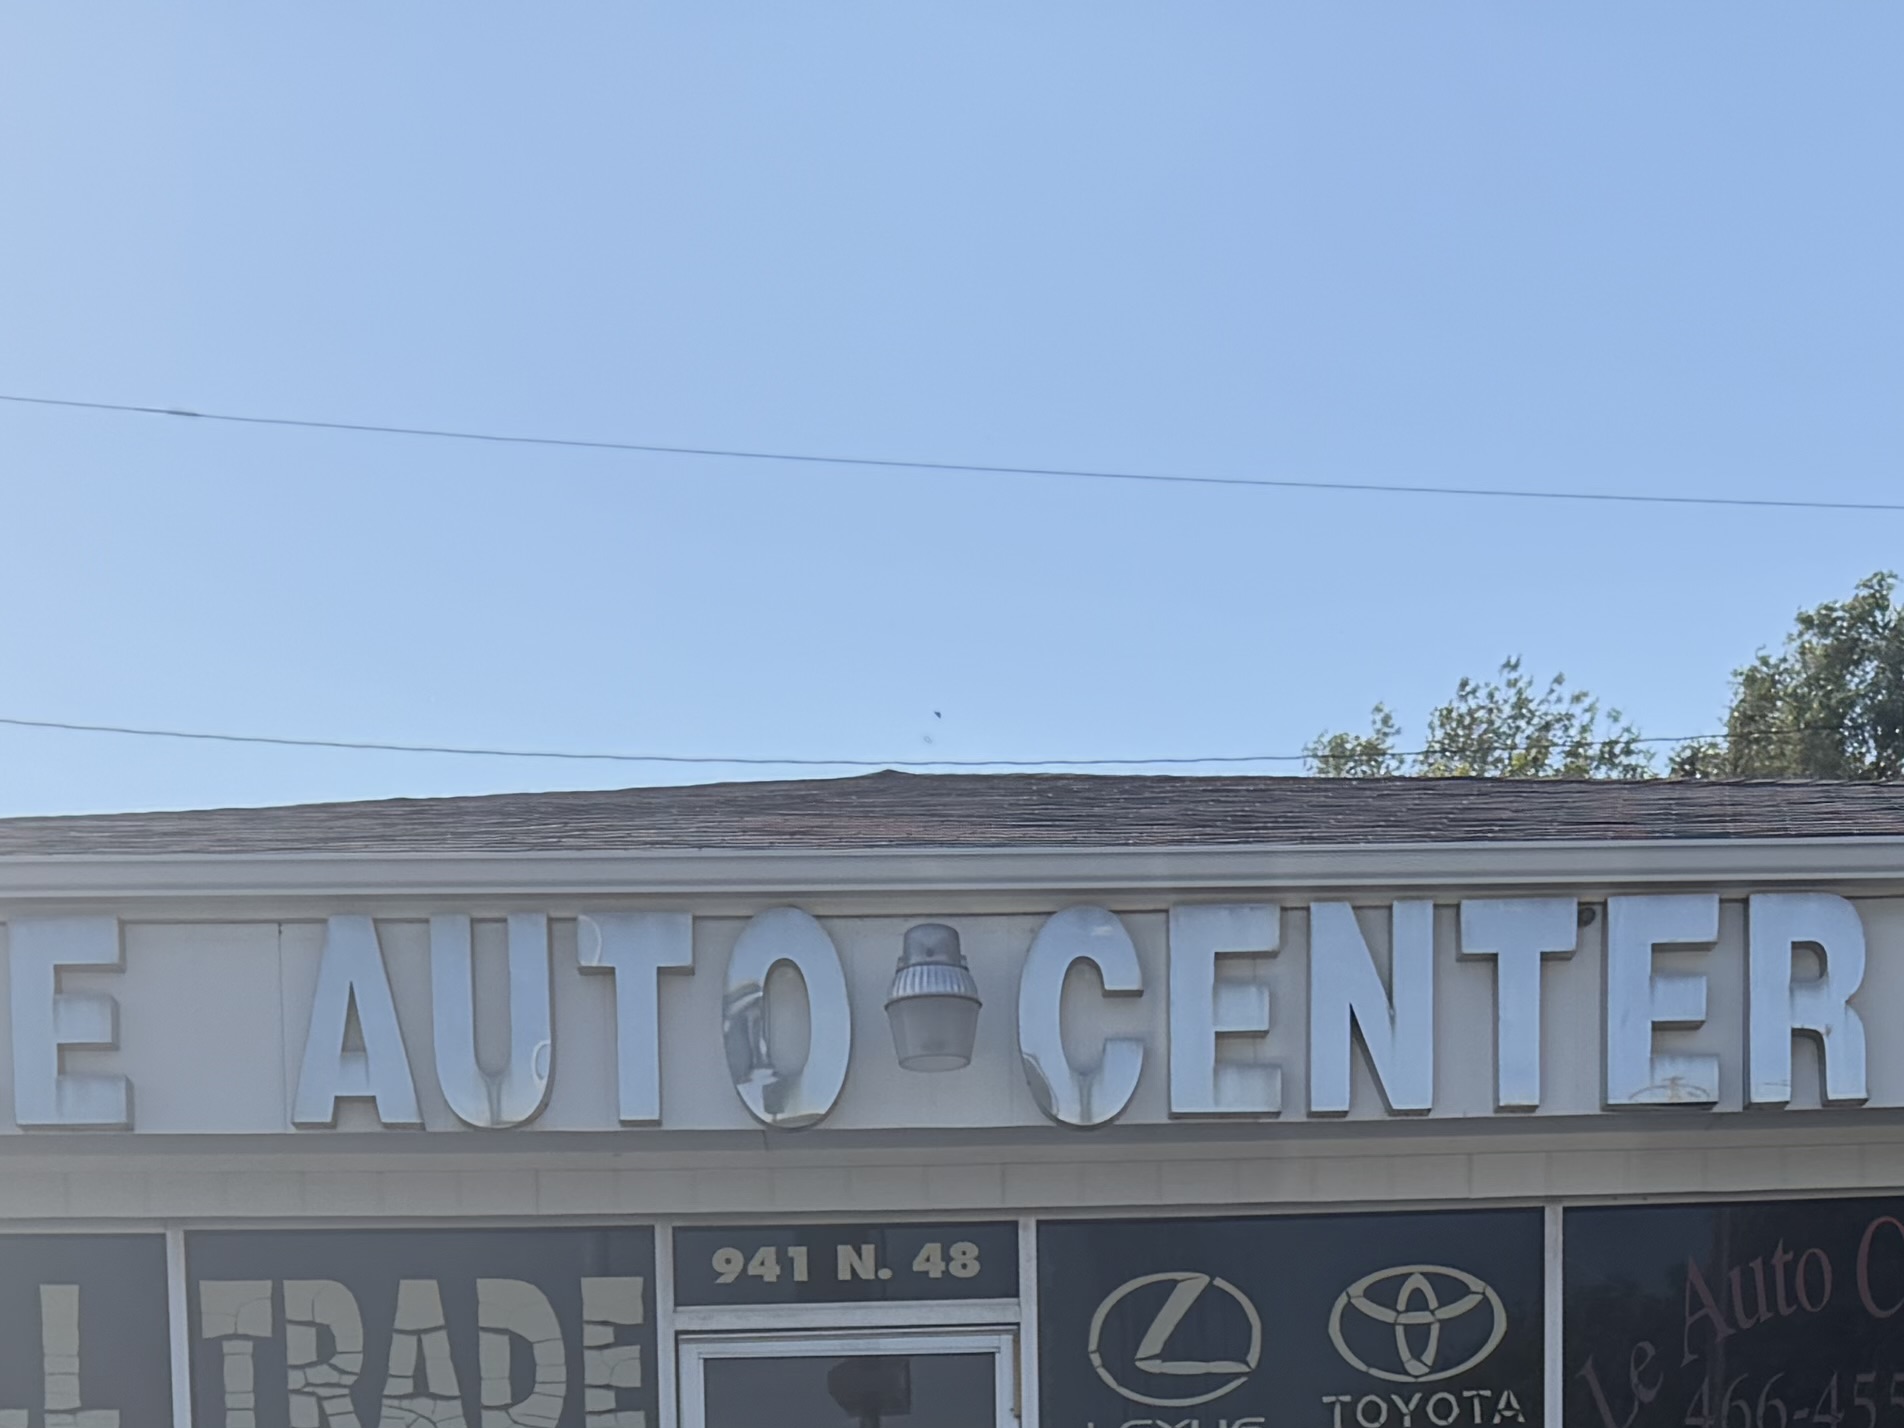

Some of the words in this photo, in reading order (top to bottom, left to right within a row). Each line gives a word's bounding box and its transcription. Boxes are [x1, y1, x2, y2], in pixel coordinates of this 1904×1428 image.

[292, 905, 851, 1130] AUTO
[1018, 891, 1868, 1128] CENTER
[711, 1243, 809, 1285] 941
[836, 1243, 892, 1282] N.
[912, 1240, 981, 1279] 48
[1680, 1237, 1833, 1368] Auto
